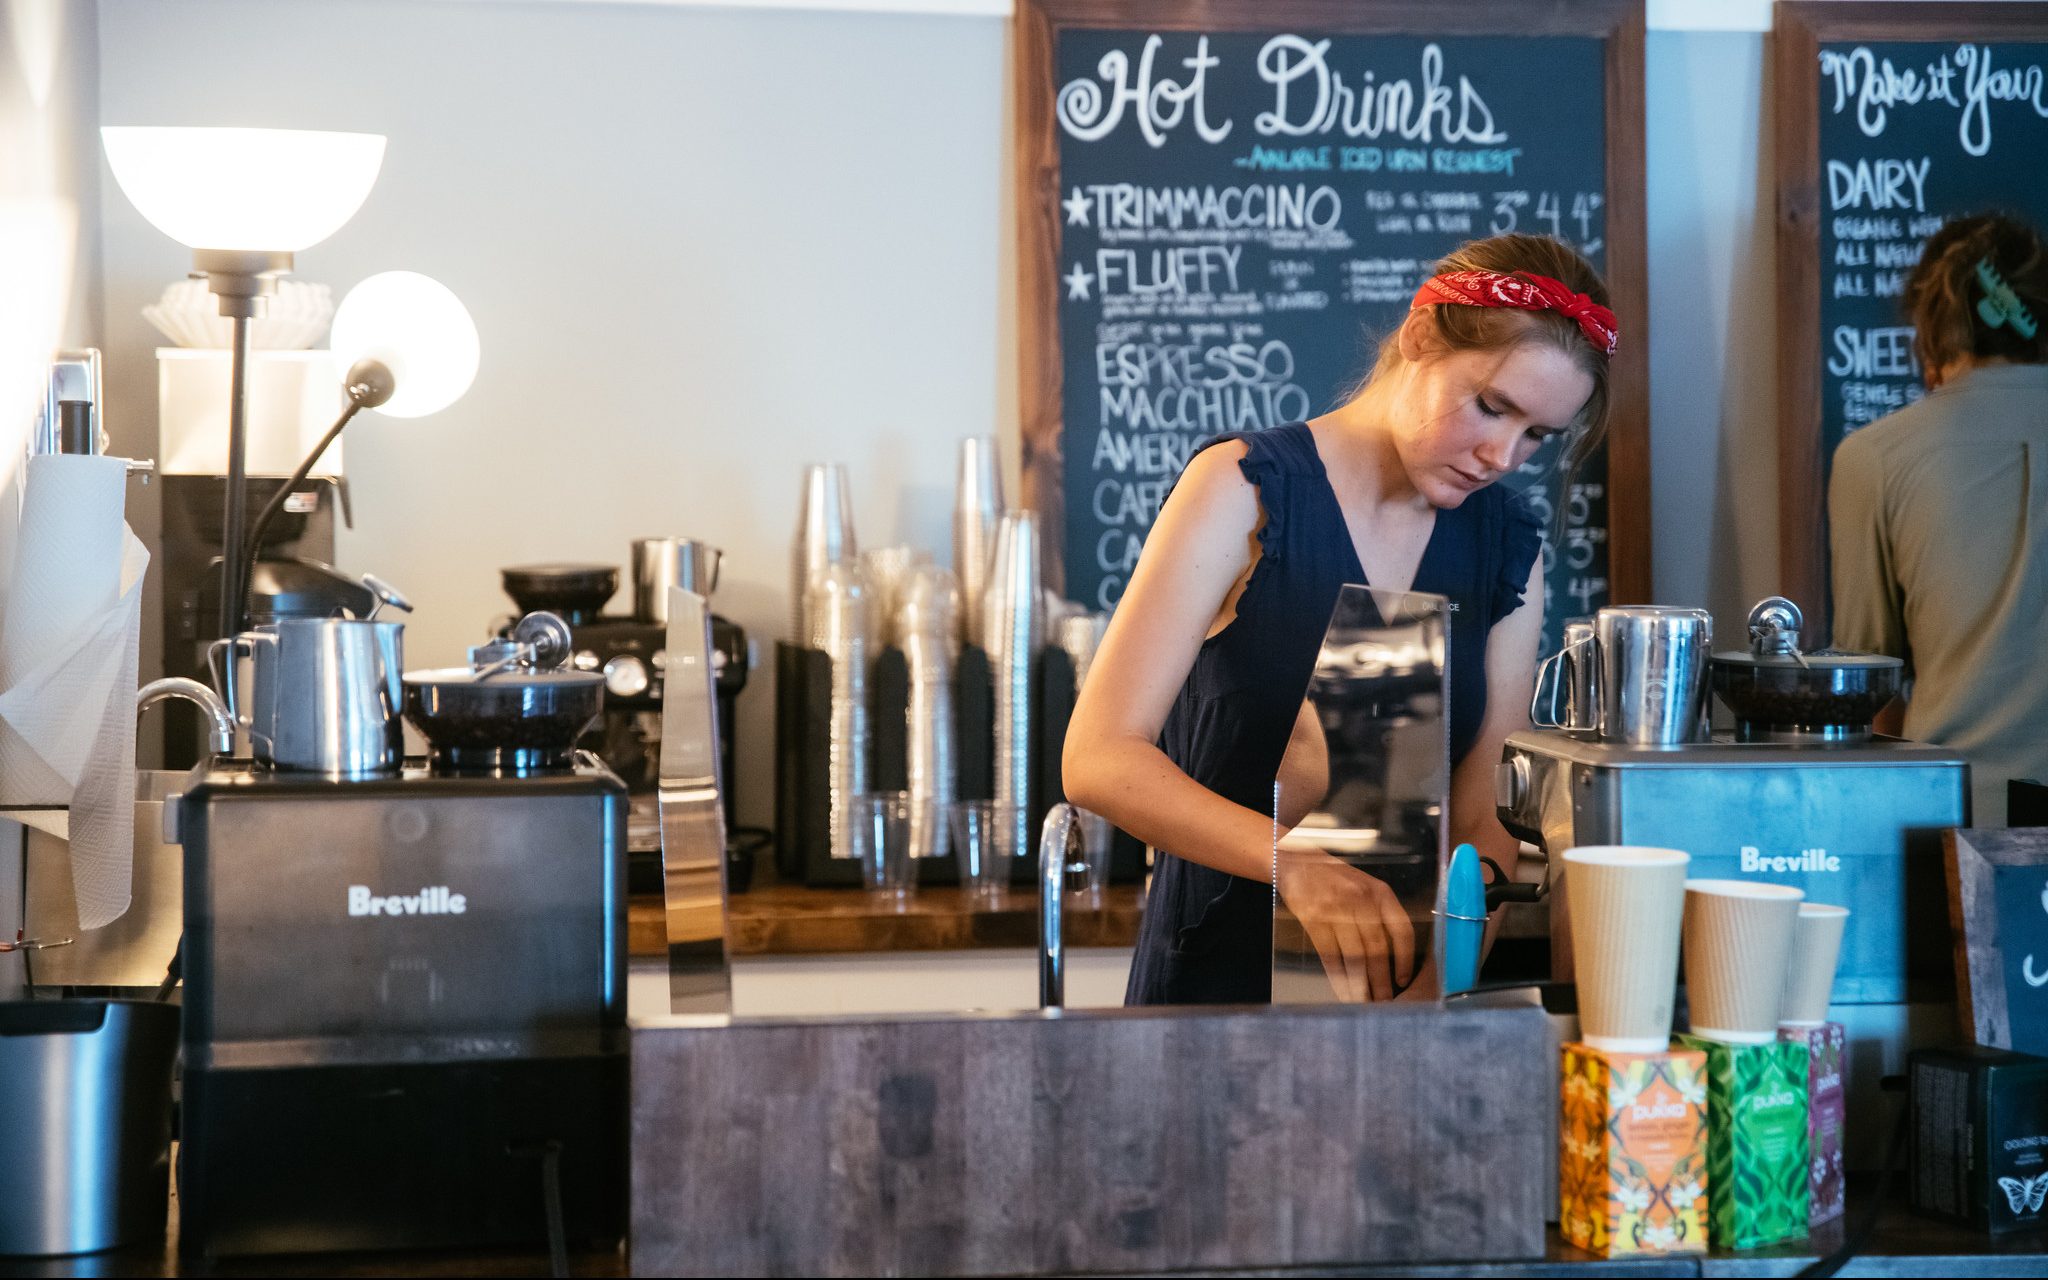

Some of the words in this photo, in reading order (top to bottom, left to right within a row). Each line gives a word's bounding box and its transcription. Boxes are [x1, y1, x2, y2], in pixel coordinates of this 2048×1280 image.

[1056, 35, 1233, 148] Hot
[1254, 34, 1508, 144] Drinks
[1817, 47, 1926, 137] Make
[1926, 54, 1960, 107] it
[1086, 182, 1342, 233] TRIMMACCINO
[1827, 156, 1931, 212] DAIRY
[1097, 244, 1242, 296] FLUFFY
[1834, 240, 1870, 266] ALL
[1834, 271, 1870, 299] ALL
[1096, 340, 1295, 388] ESPRESSO
[1828, 325, 1919, 379] SWEET
[1099, 383, 1310, 432] MACCHIATO
[1740, 846, 1841, 873] Breville
[347, 884, 467, 917] Breville
